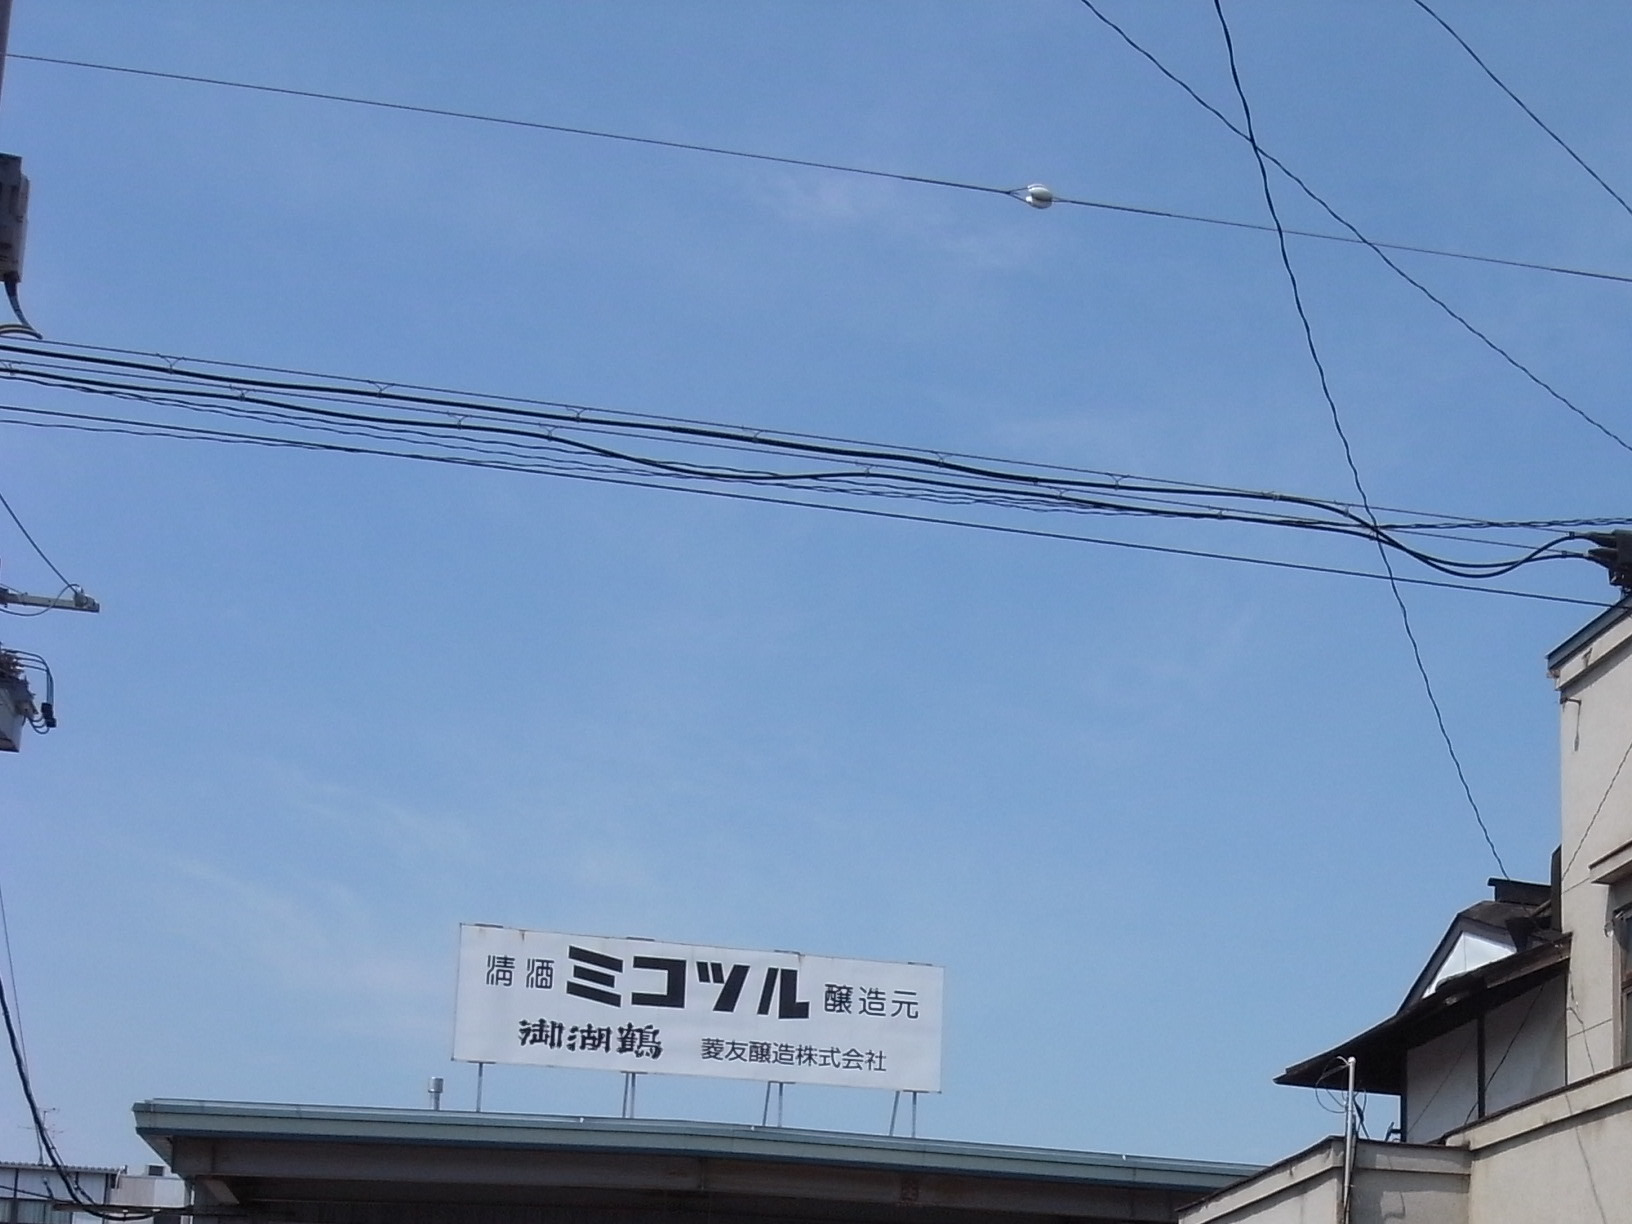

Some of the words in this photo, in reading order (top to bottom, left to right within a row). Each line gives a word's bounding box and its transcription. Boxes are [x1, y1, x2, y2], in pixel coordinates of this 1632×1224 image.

[486, 954, 555, 990] 清酒
[566, 944, 811, 1020] ミコツル
[824, 982, 920, 1020] 醸造元
[518, 1018, 664, 1060] 御湖鶴
[700, 1037, 888, 1072] 菱友醸造株式会社
